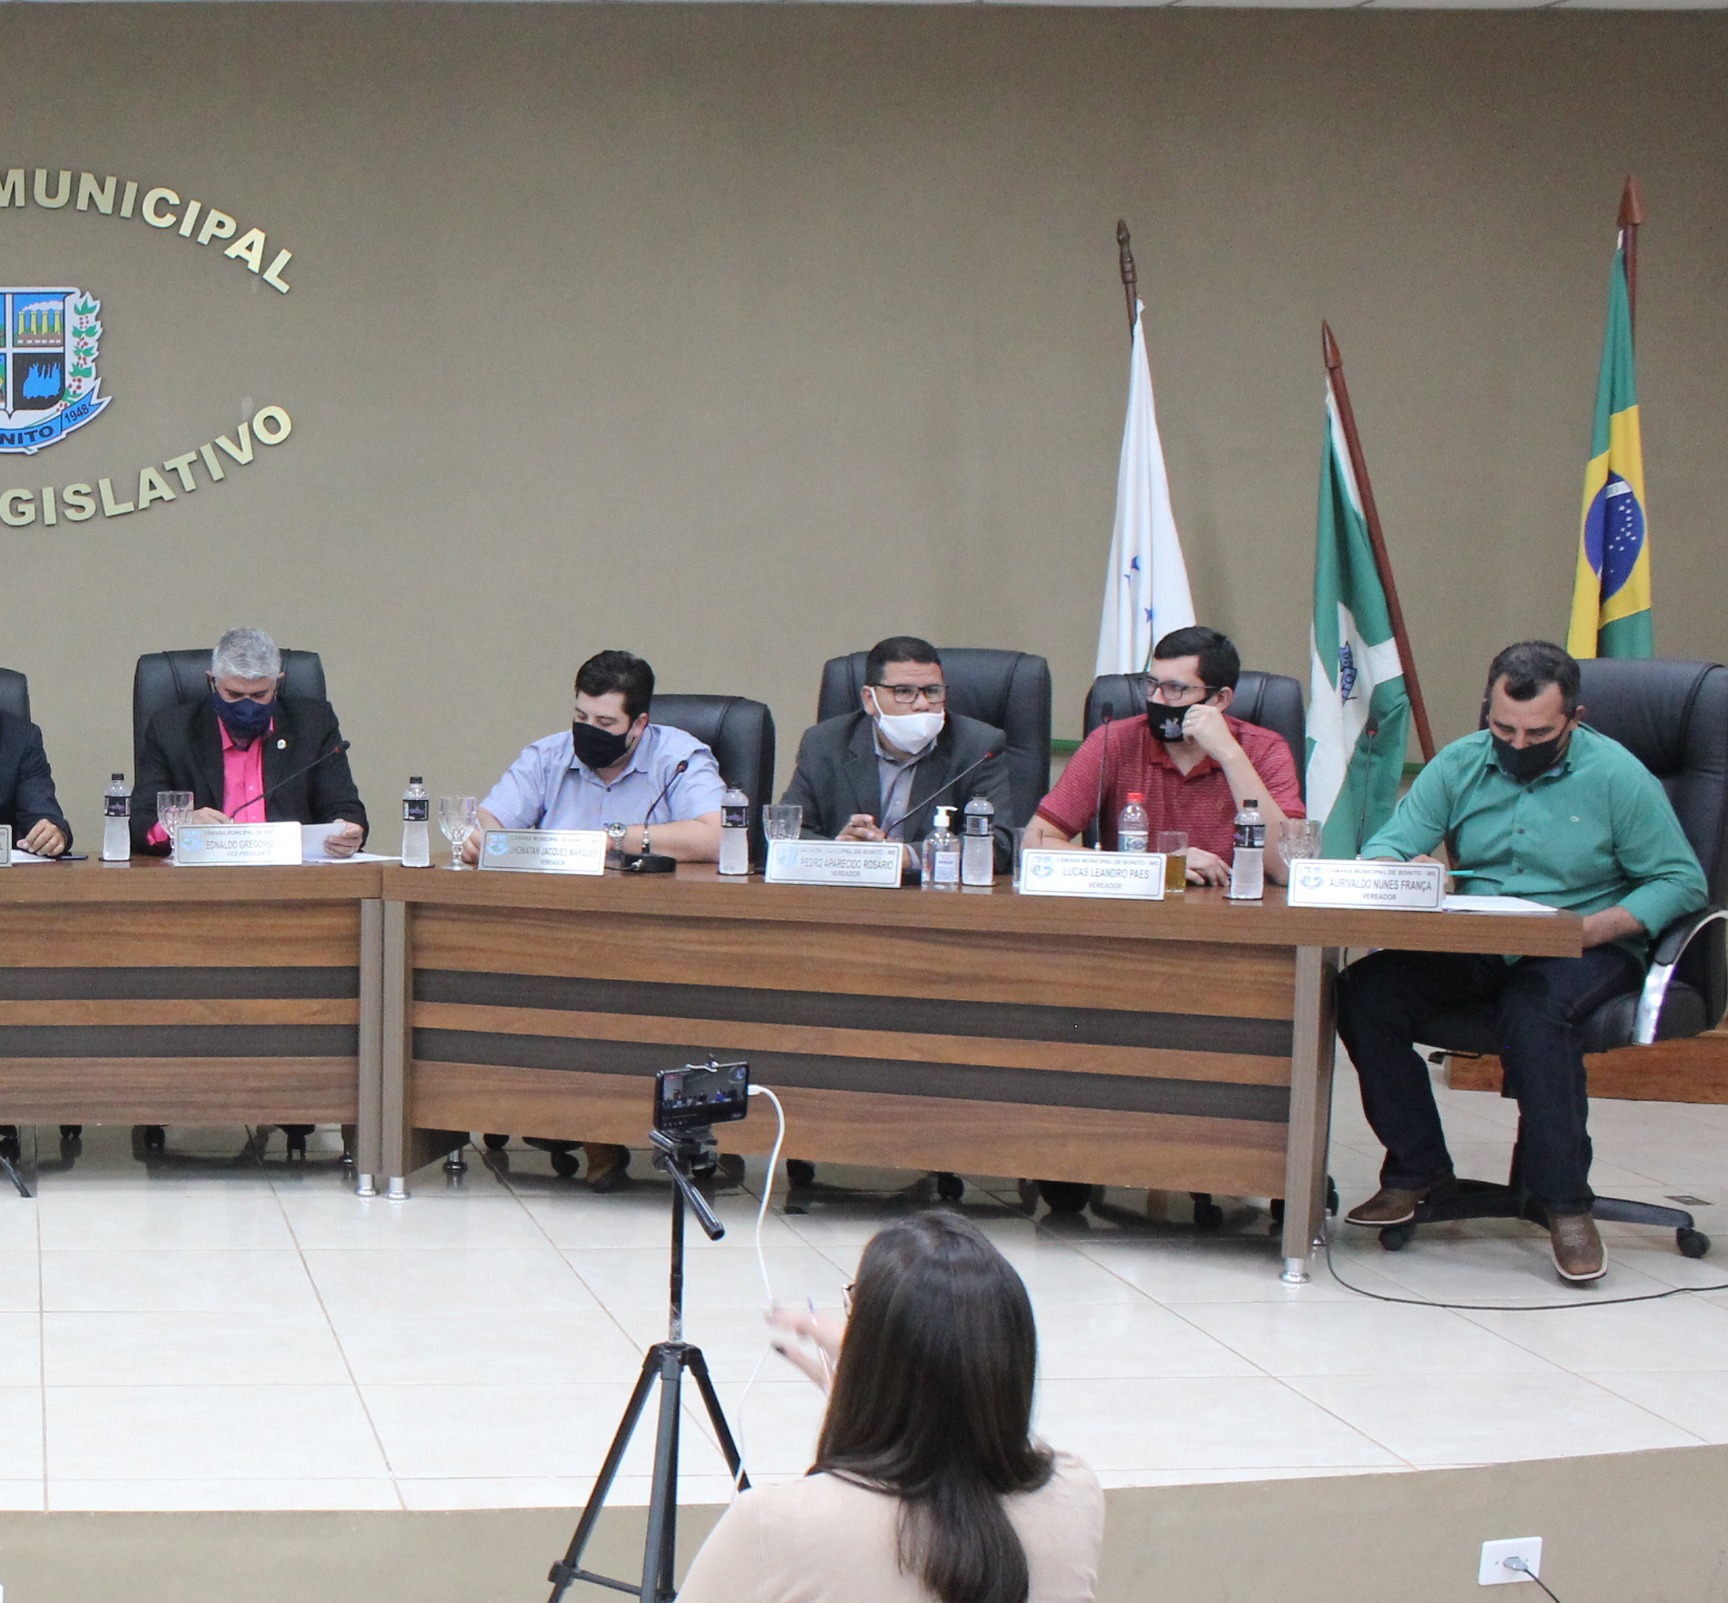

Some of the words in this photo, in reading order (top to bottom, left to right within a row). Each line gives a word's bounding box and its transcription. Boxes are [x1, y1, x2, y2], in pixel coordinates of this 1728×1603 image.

[64, 403, 89, 424] 1948
[824, 858, 862, 869] APARECIDO
[1063, 866, 1088, 877] LUCAS
[1090, 867, 1127, 879] LEANDRO
[1129, 869, 1149, 880] PAES
[1398, 869, 1422, 877] BONITO
[1329, 879, 1371, 890] AURIVALDO
[1373, 880, 1399, 891] NUNES
[1401, 880, 1432, 893] FRANÇA
[1362, 893, 1397, 901] VEREADOR
